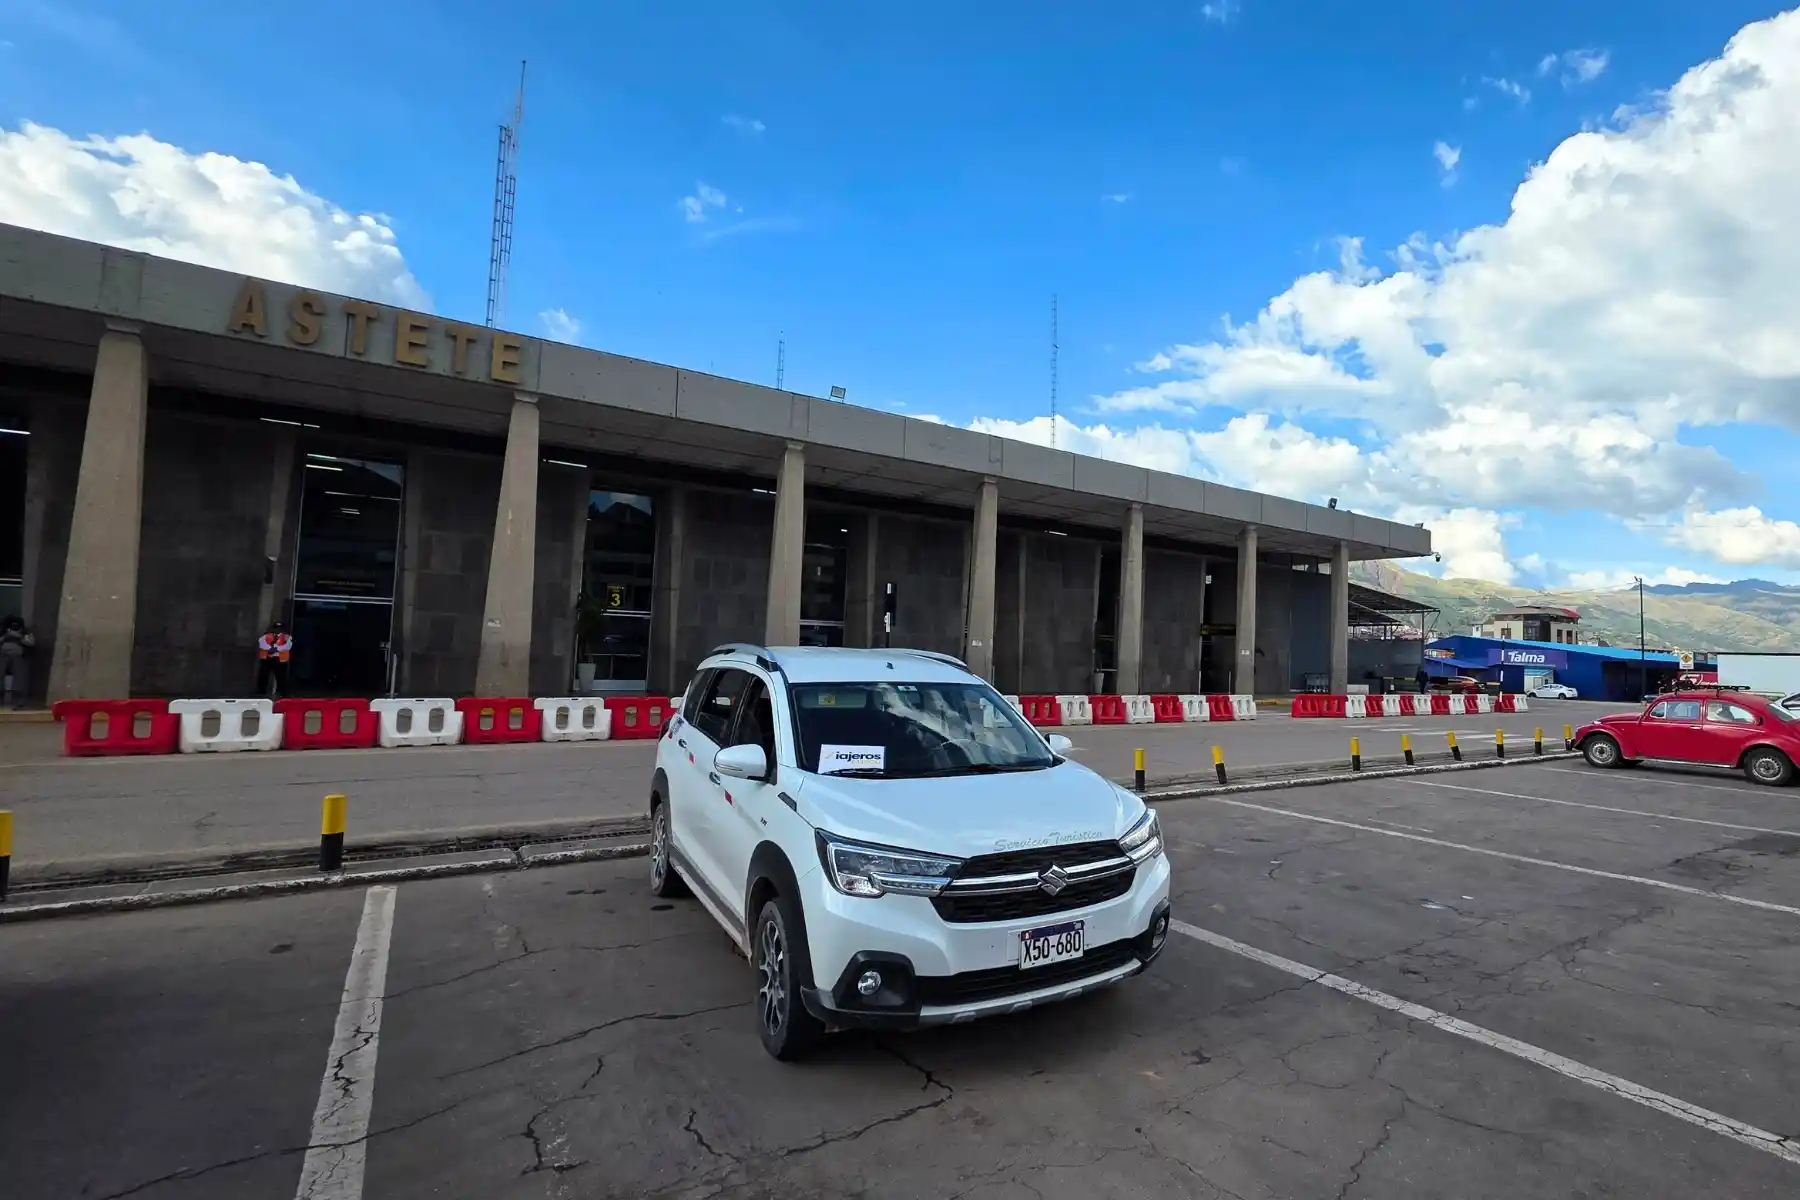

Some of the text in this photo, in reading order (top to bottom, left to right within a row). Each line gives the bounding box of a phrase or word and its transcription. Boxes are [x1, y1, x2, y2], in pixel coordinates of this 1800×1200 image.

[227, 276, 523, 386] ASTETE
[610, 593, 621, 607] 3
[1508, 651, 1545, 663] Talma
[994, 838, 1049, 851] Servicio
